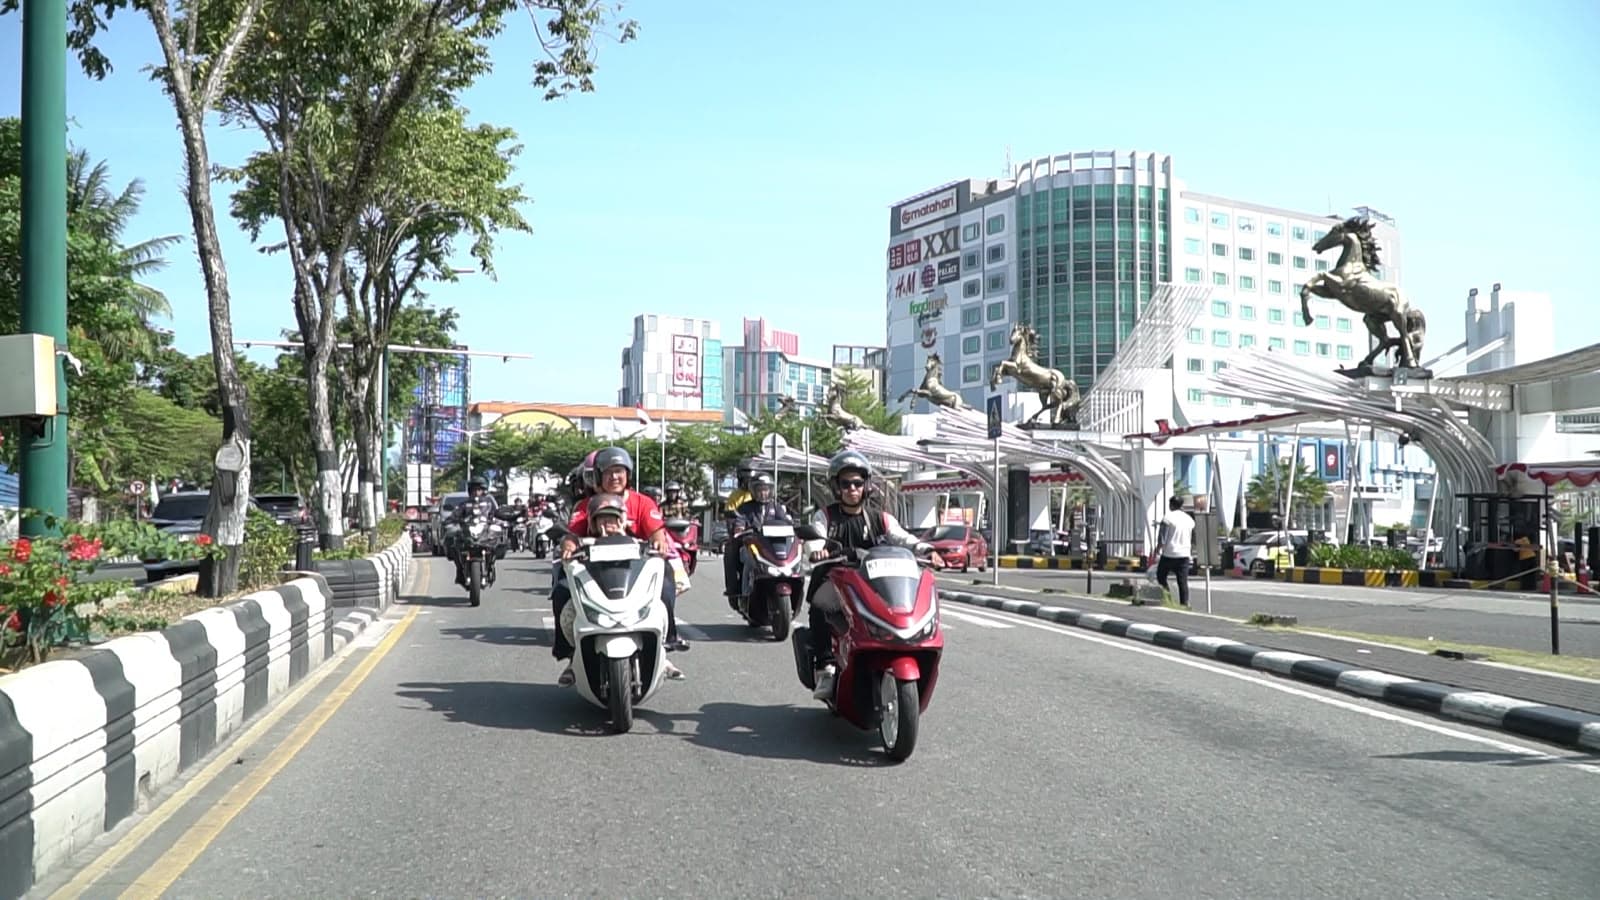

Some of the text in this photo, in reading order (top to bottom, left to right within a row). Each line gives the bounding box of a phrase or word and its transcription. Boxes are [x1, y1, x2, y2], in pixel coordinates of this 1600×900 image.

[911, 193, 954, 220] matahari
[923, 227, 959, 259] XXI
[895, 271, 917, 298] H&M
